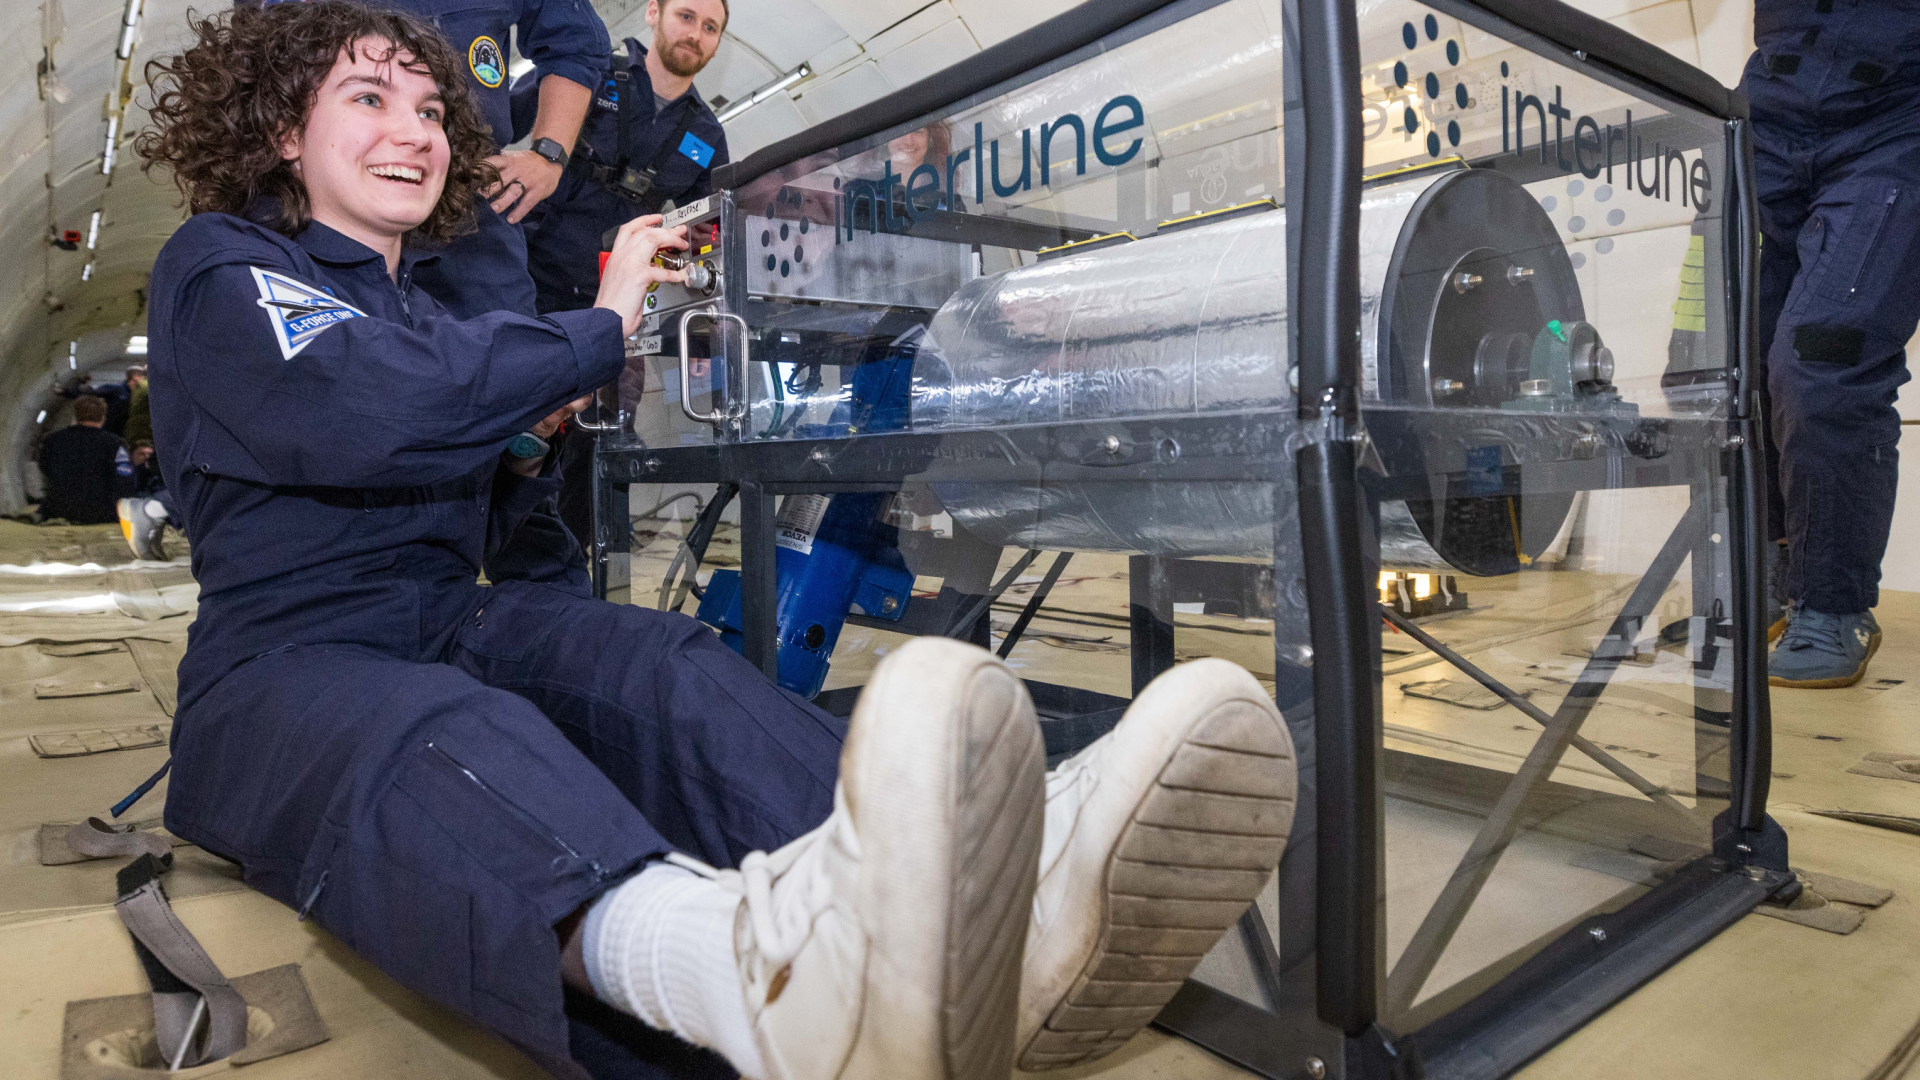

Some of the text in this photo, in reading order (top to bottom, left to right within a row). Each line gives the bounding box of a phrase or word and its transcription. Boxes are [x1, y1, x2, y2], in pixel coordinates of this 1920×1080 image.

[597, 97, 619, 111] zero
[1501, 60, 1711, 213] interlune
[833, 94, 1144, 245] interlune
[290, 312, 335, 332] G-FORCE
[782, 530, 806, 542] VEVOR
